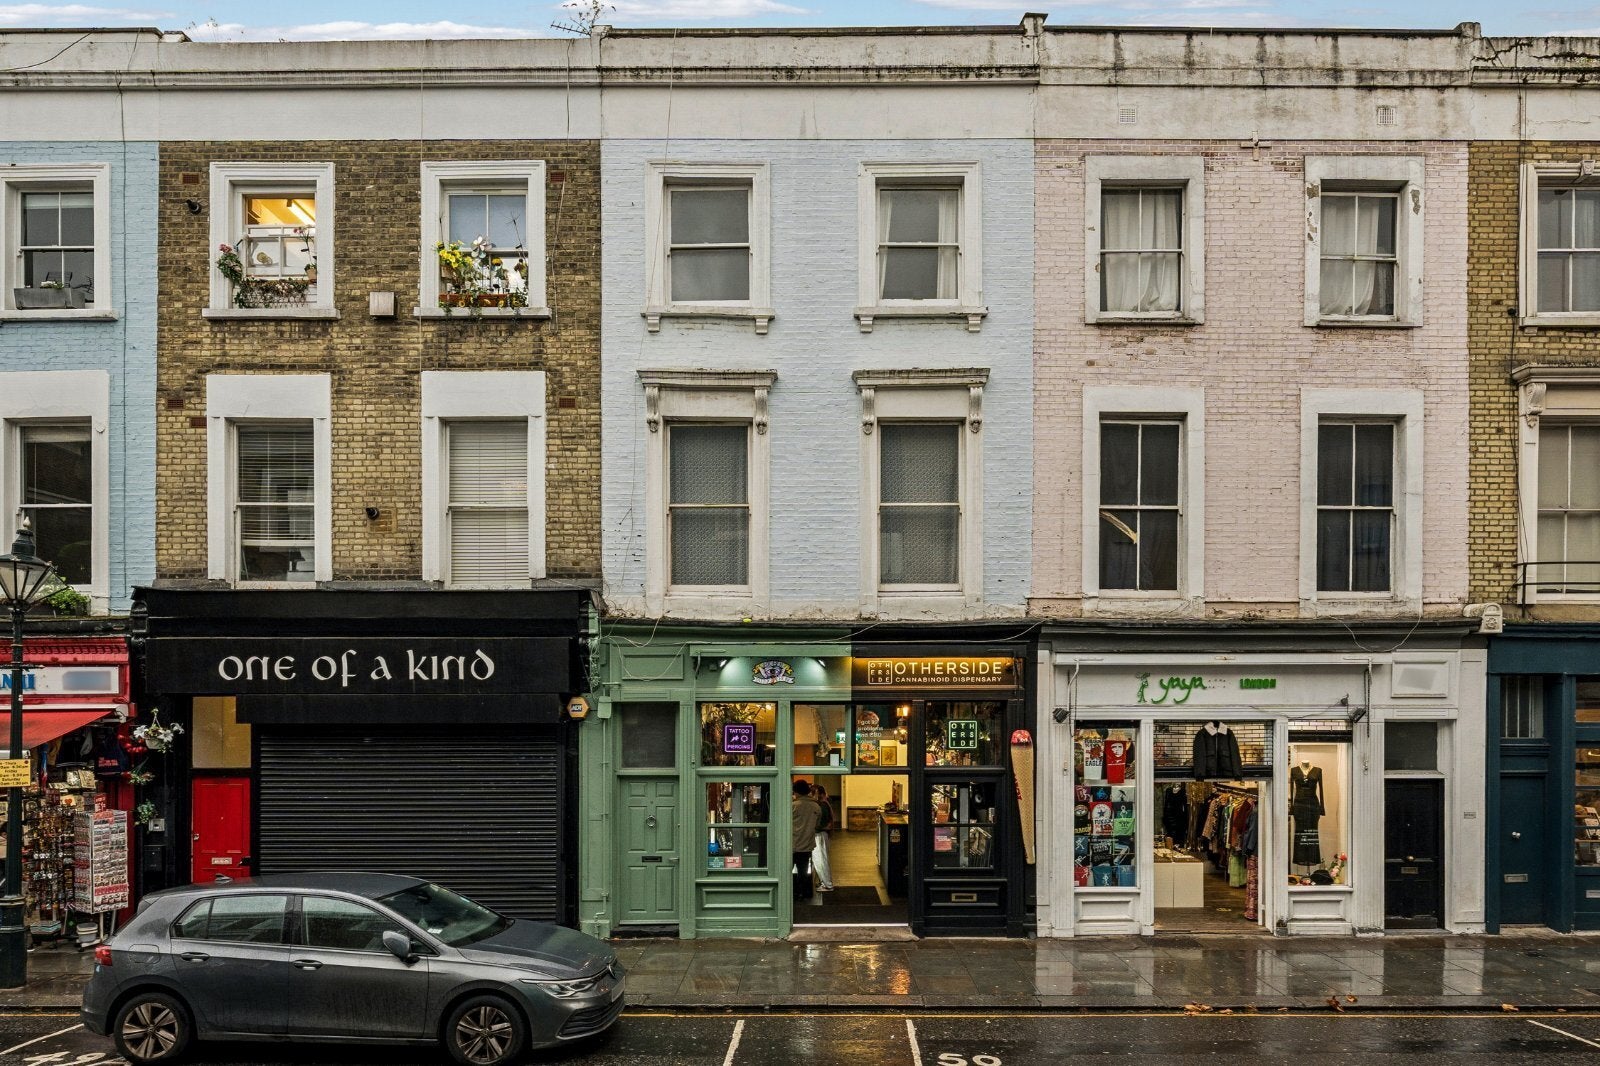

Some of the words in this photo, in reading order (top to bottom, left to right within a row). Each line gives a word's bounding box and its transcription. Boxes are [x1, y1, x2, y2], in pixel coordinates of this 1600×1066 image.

[894, 661, 1002, 675] OTHERSIDE
[1151, 676, 1207, 704] yaya
[1240, 678, 1277, 690] LONDON
